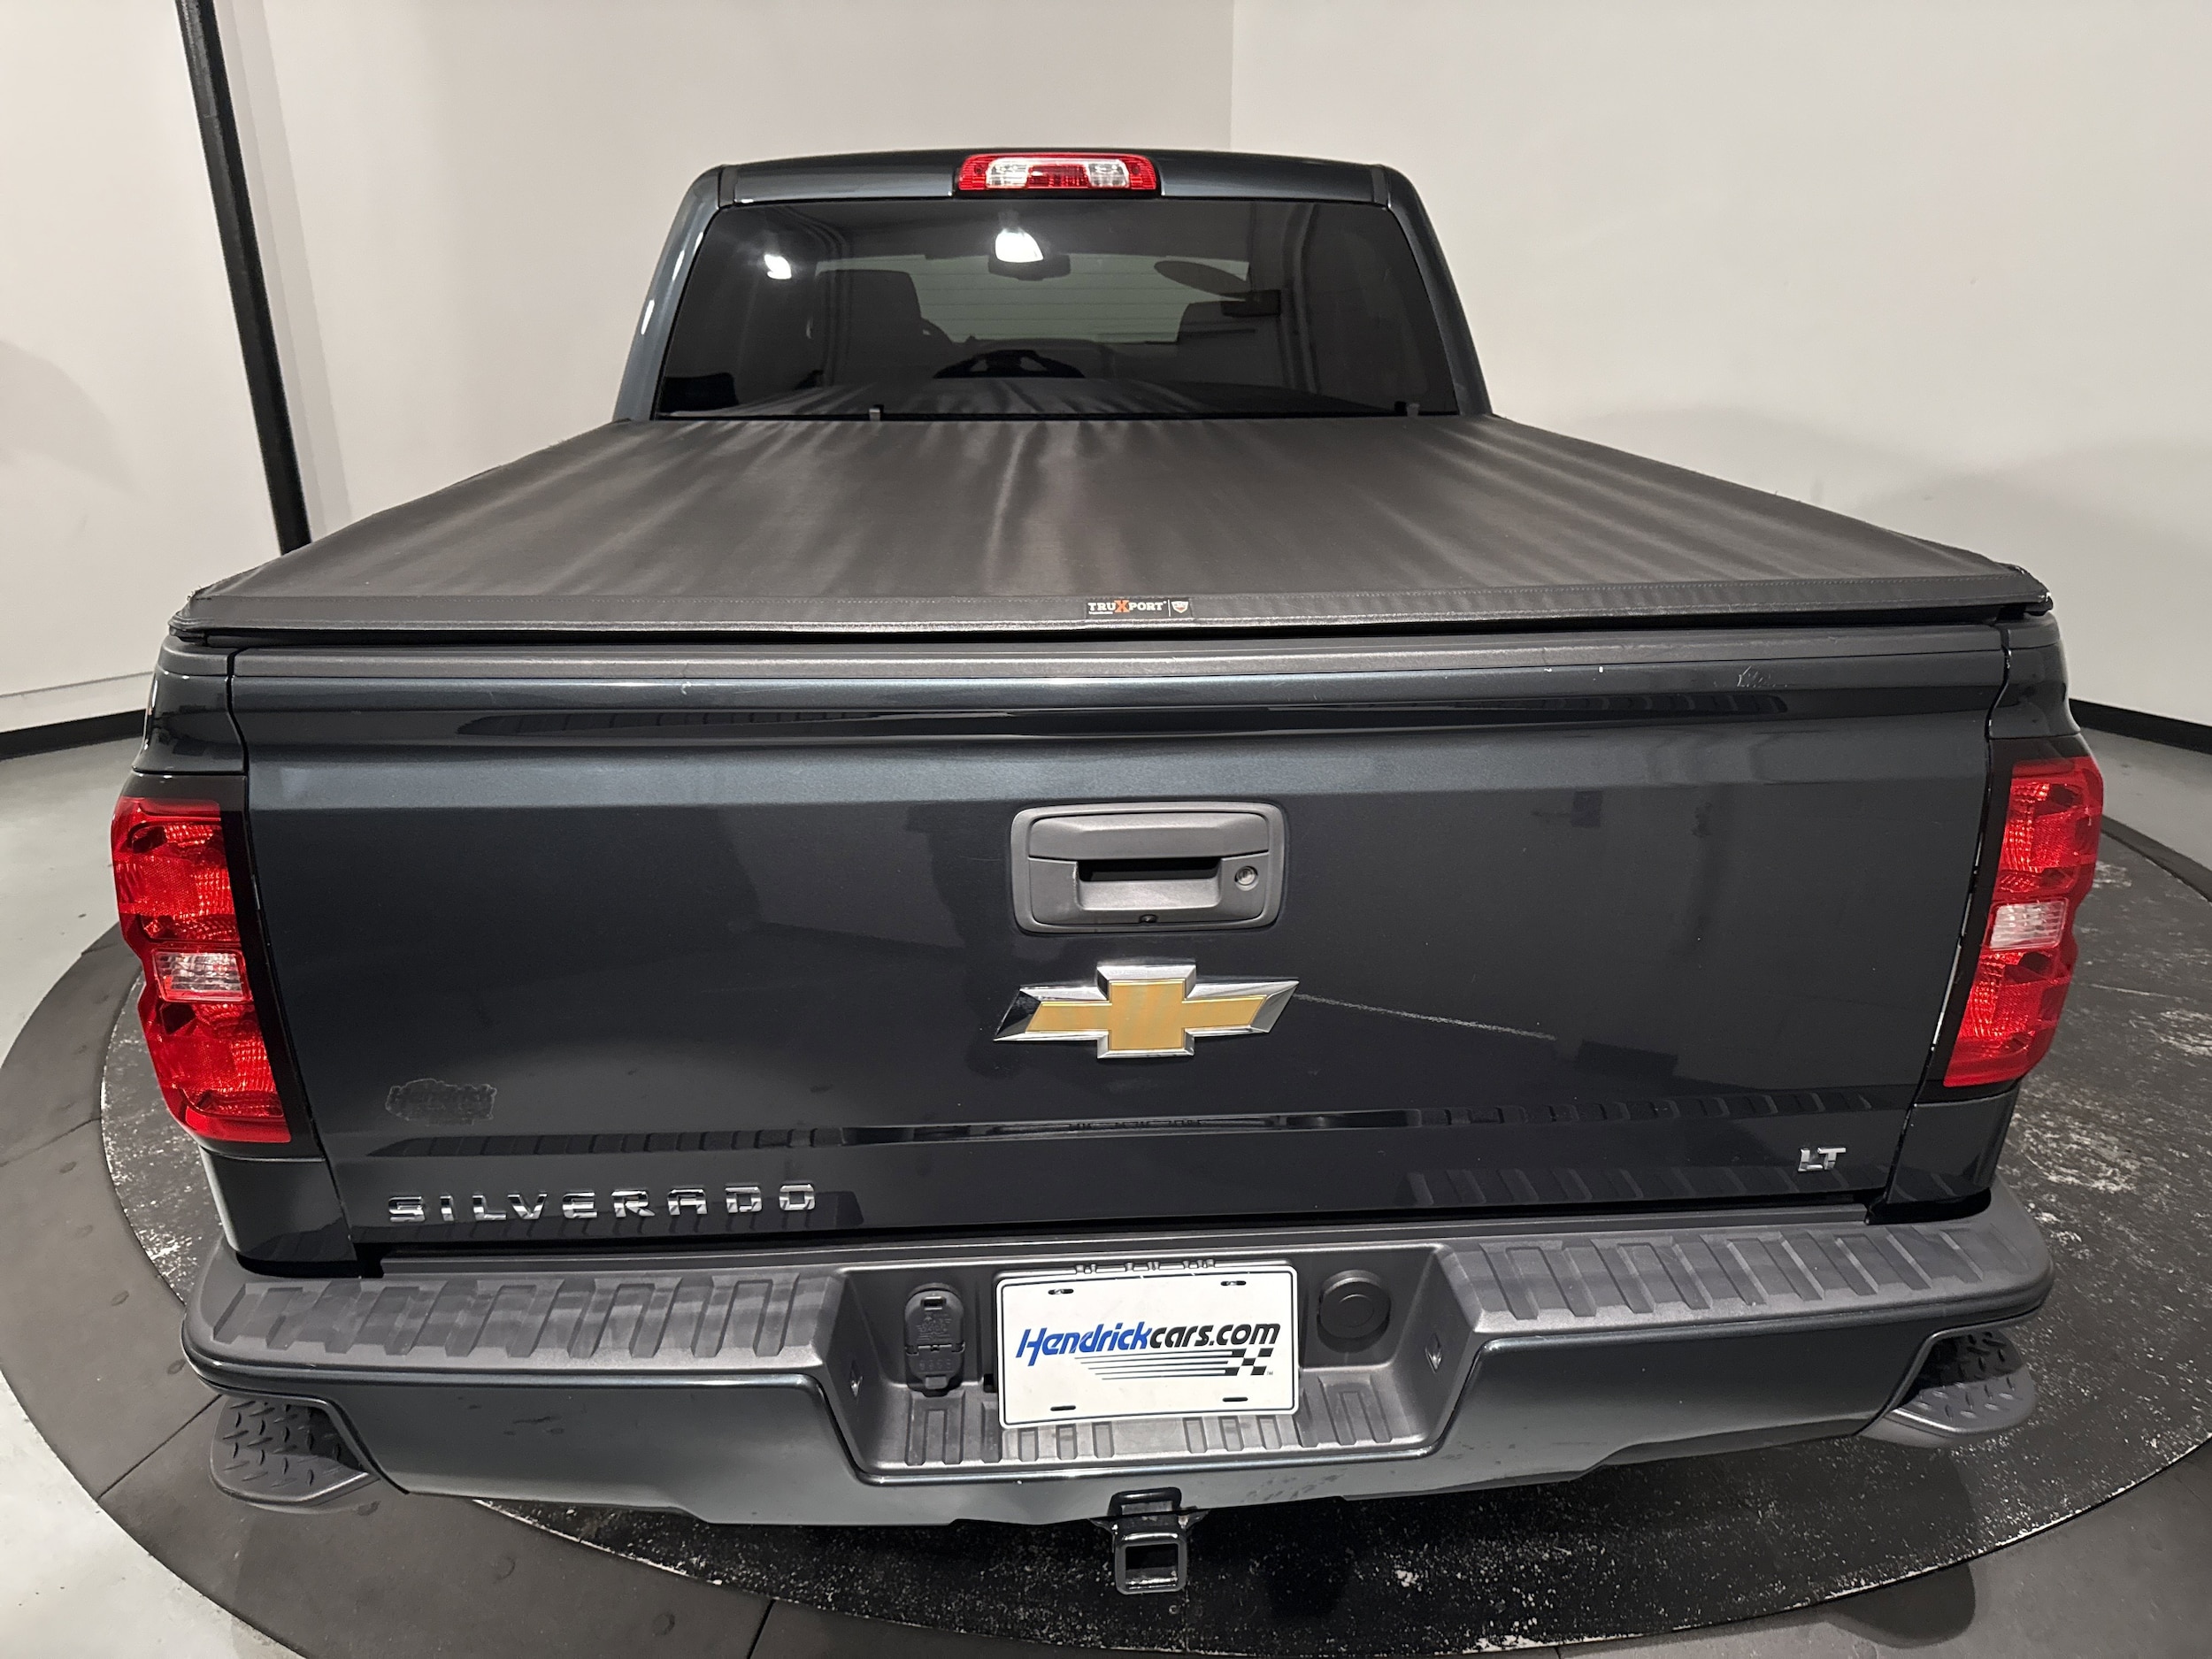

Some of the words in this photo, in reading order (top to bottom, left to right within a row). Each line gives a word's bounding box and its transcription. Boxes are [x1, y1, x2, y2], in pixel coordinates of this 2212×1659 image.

[1087, 600, 1164, 613] TRUXPORT
[1798, 1147, 1847, 1172] LT
[388, 1183, 816, 1222] SILVERADO
[1015, 1321, 1281, 1367] Hendrickcars.com
